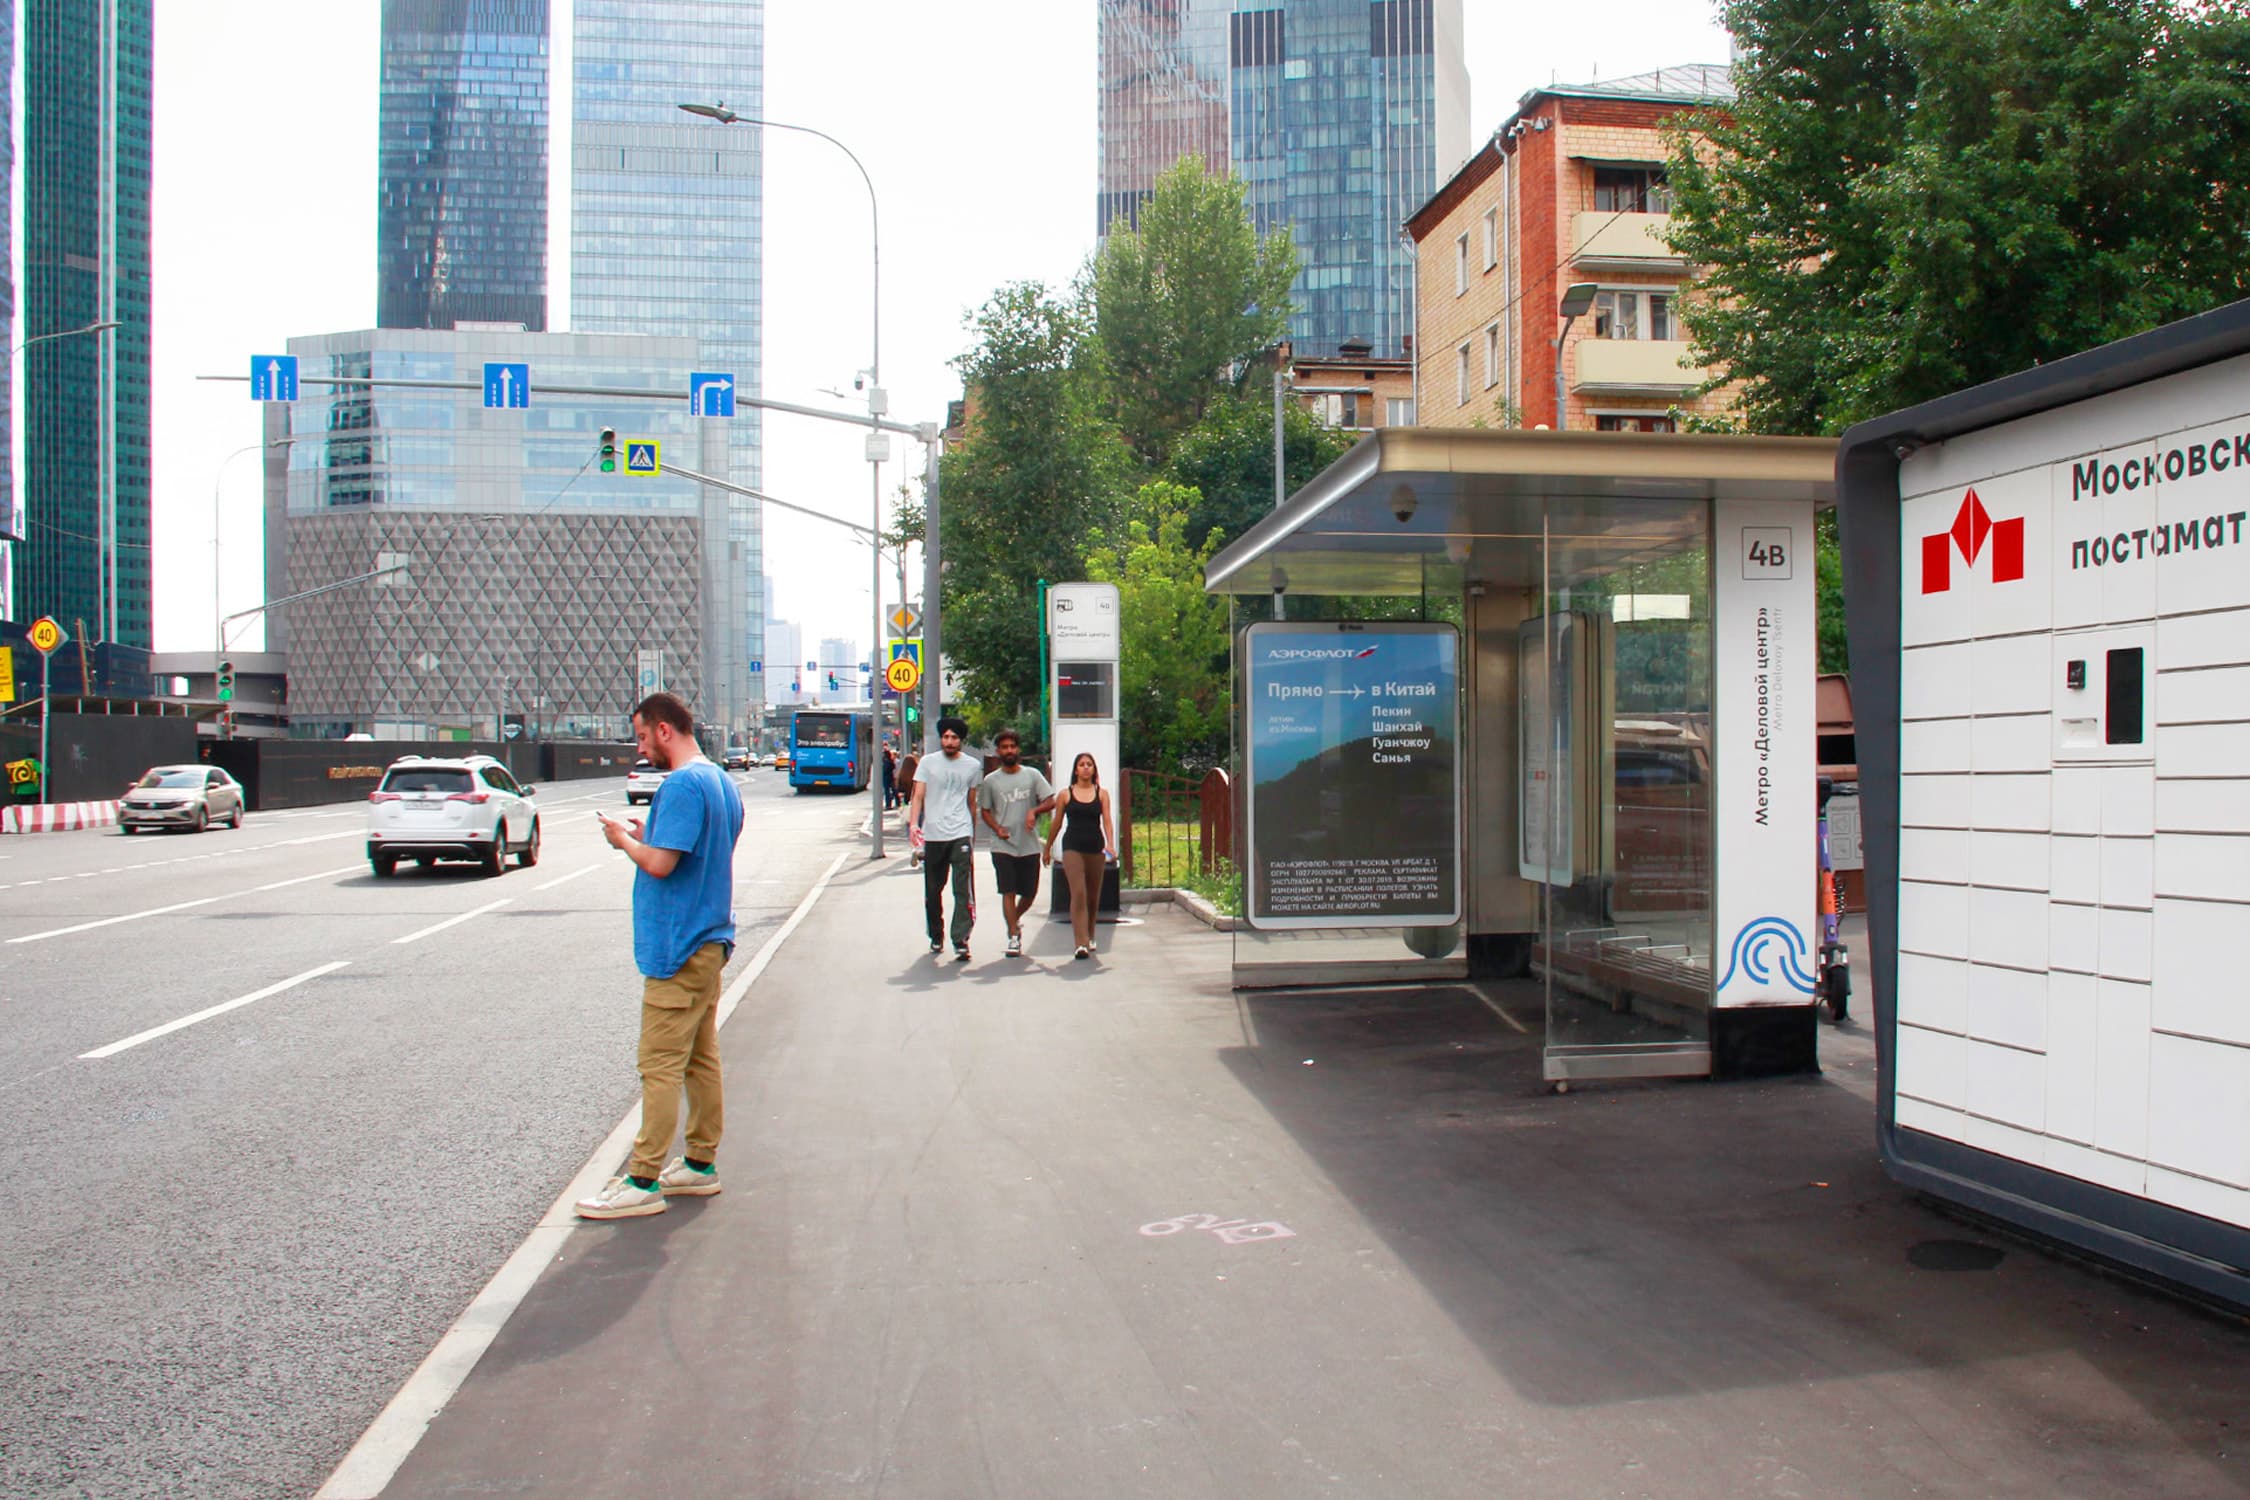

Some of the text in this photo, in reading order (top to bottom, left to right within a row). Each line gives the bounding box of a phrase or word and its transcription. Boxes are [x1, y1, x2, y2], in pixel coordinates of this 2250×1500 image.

[2072, 510, 2247, 570] постамат
[37, 628, 52, 642] 40
[1268, 649, 1355, 659] АЭРОФЛОТ
[893, 668, 910, 683] 40
[1268, 681, 1436, 700] Прямо в Китай
[1372, 705, 1412, 717] Пекин
[1754, 607, 1772, 826] Метро «Деловой центр»
[1372, 720, 1423, 732] Шанхай
[1372, 737, 1431, 750] Гуанчжоу
[1372, 752, 1412, 764] Санья
